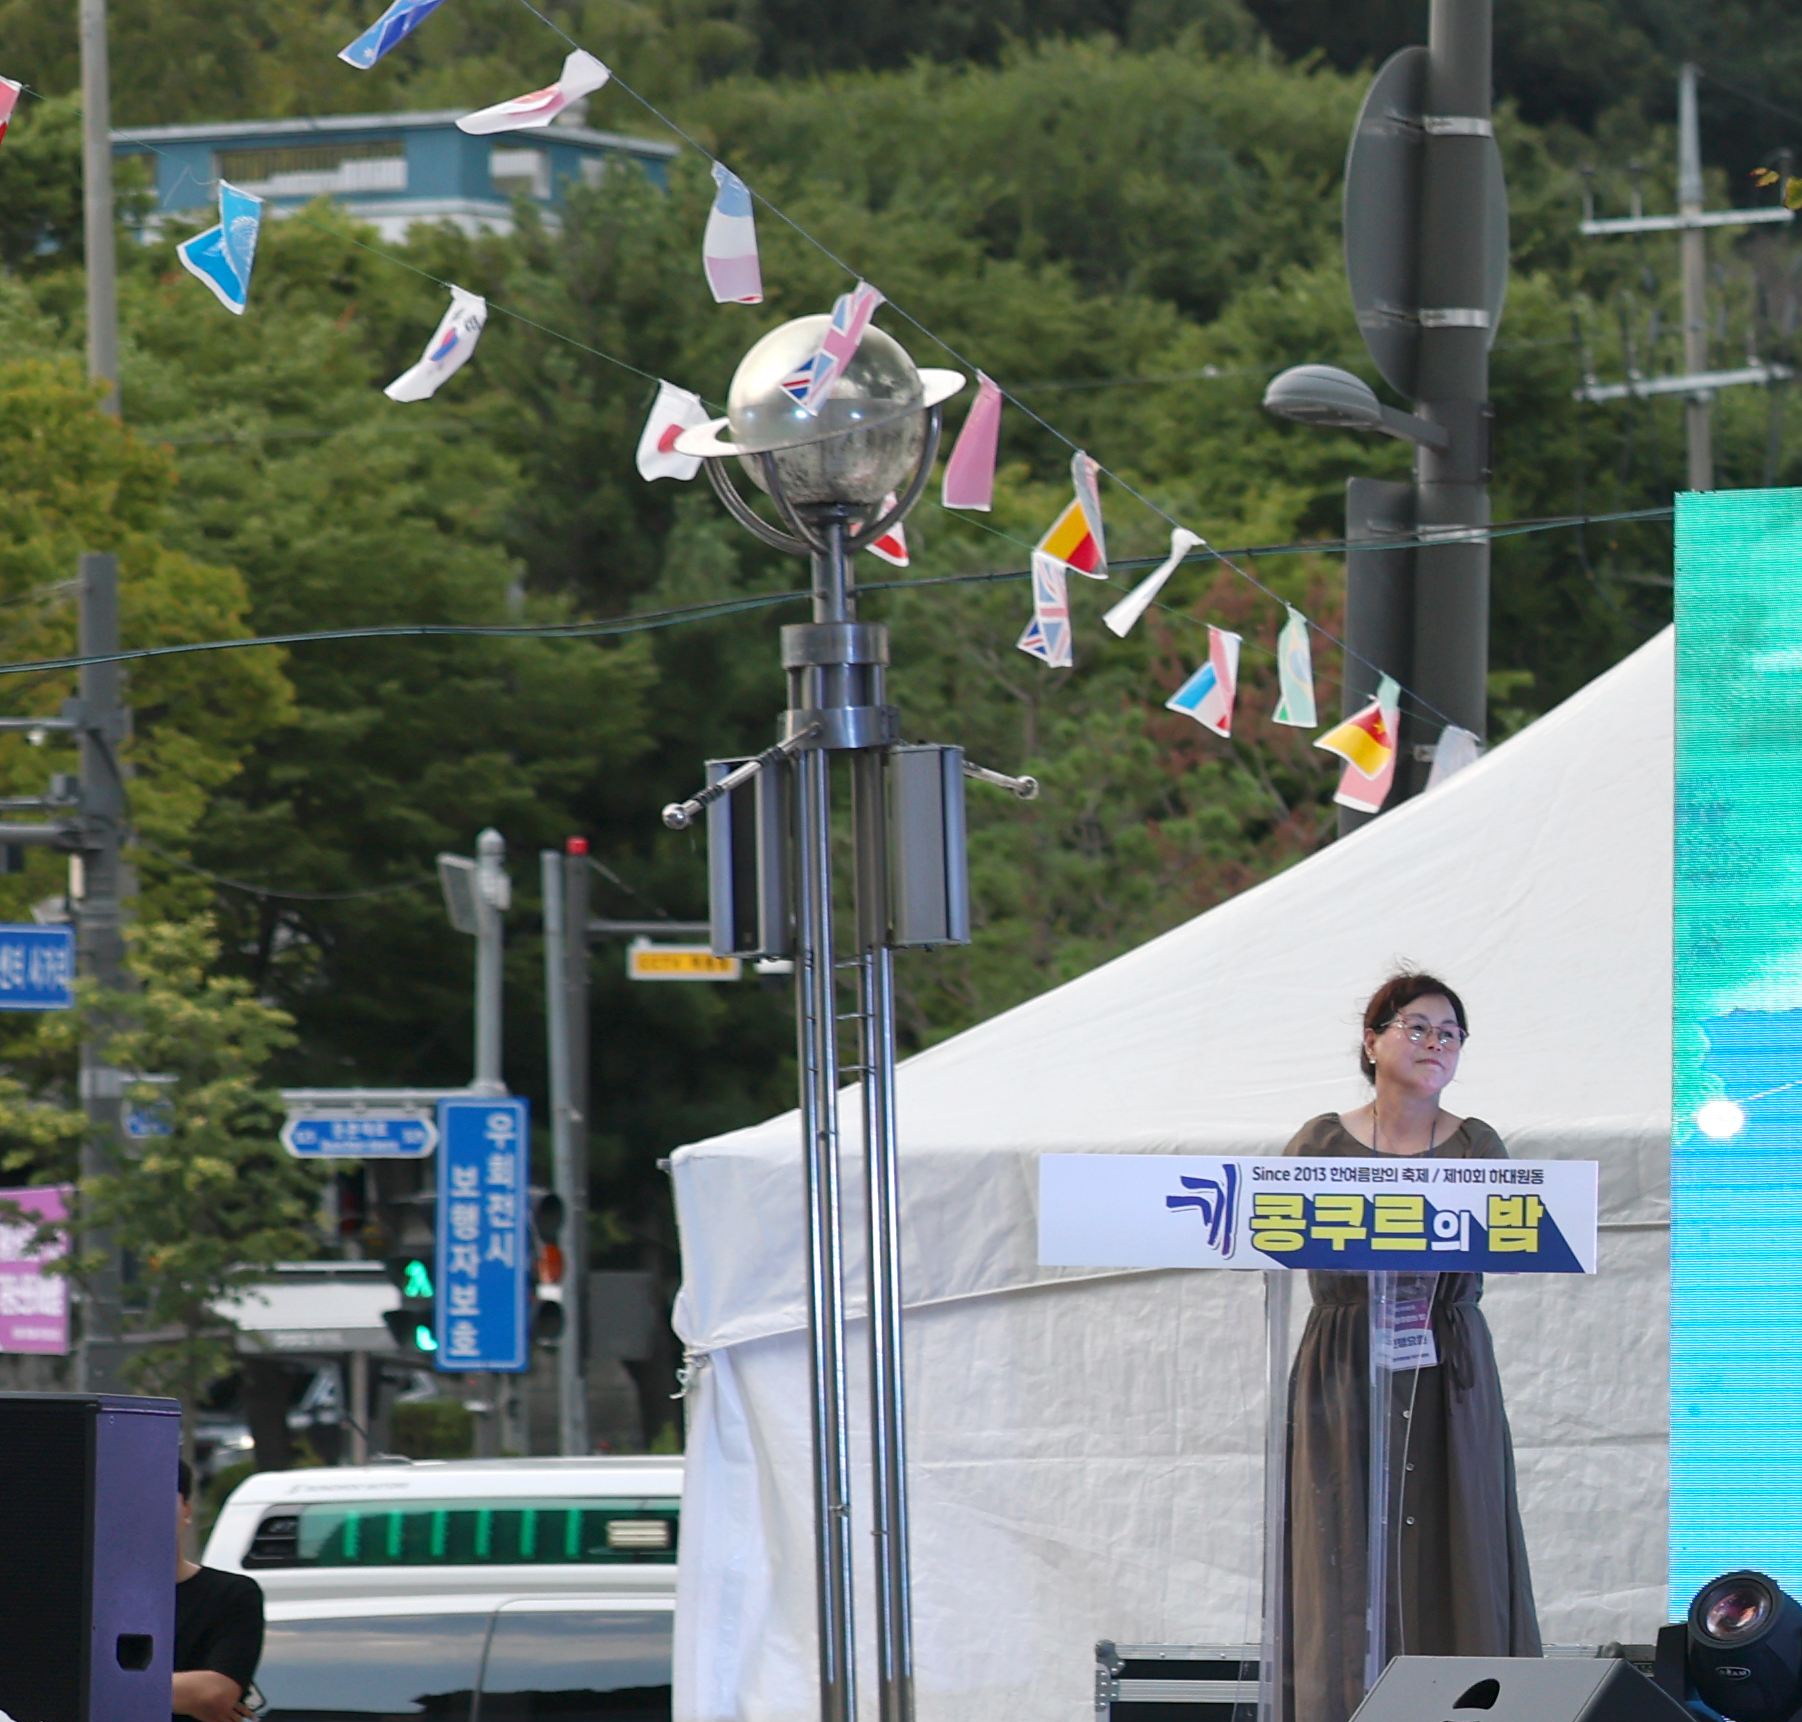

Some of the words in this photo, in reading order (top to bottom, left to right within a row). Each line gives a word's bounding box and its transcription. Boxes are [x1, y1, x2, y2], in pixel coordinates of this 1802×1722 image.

[1252, 1166, 1290, 1182] Since
[1294, 1167, 1326, 1182] 2013
[1330, 1167, 1398, 1183] 한여름밤의
[1402, 1168, 1429, 1183] 축제
[1443, 1168, 1485, 1184] 제10회
[1490, 1169, 1544, 1185] 하대원동
[1249, 1193, 1470, 1252] 콩쿠르의
[1487, 1194, 1544, 1253] 밤
